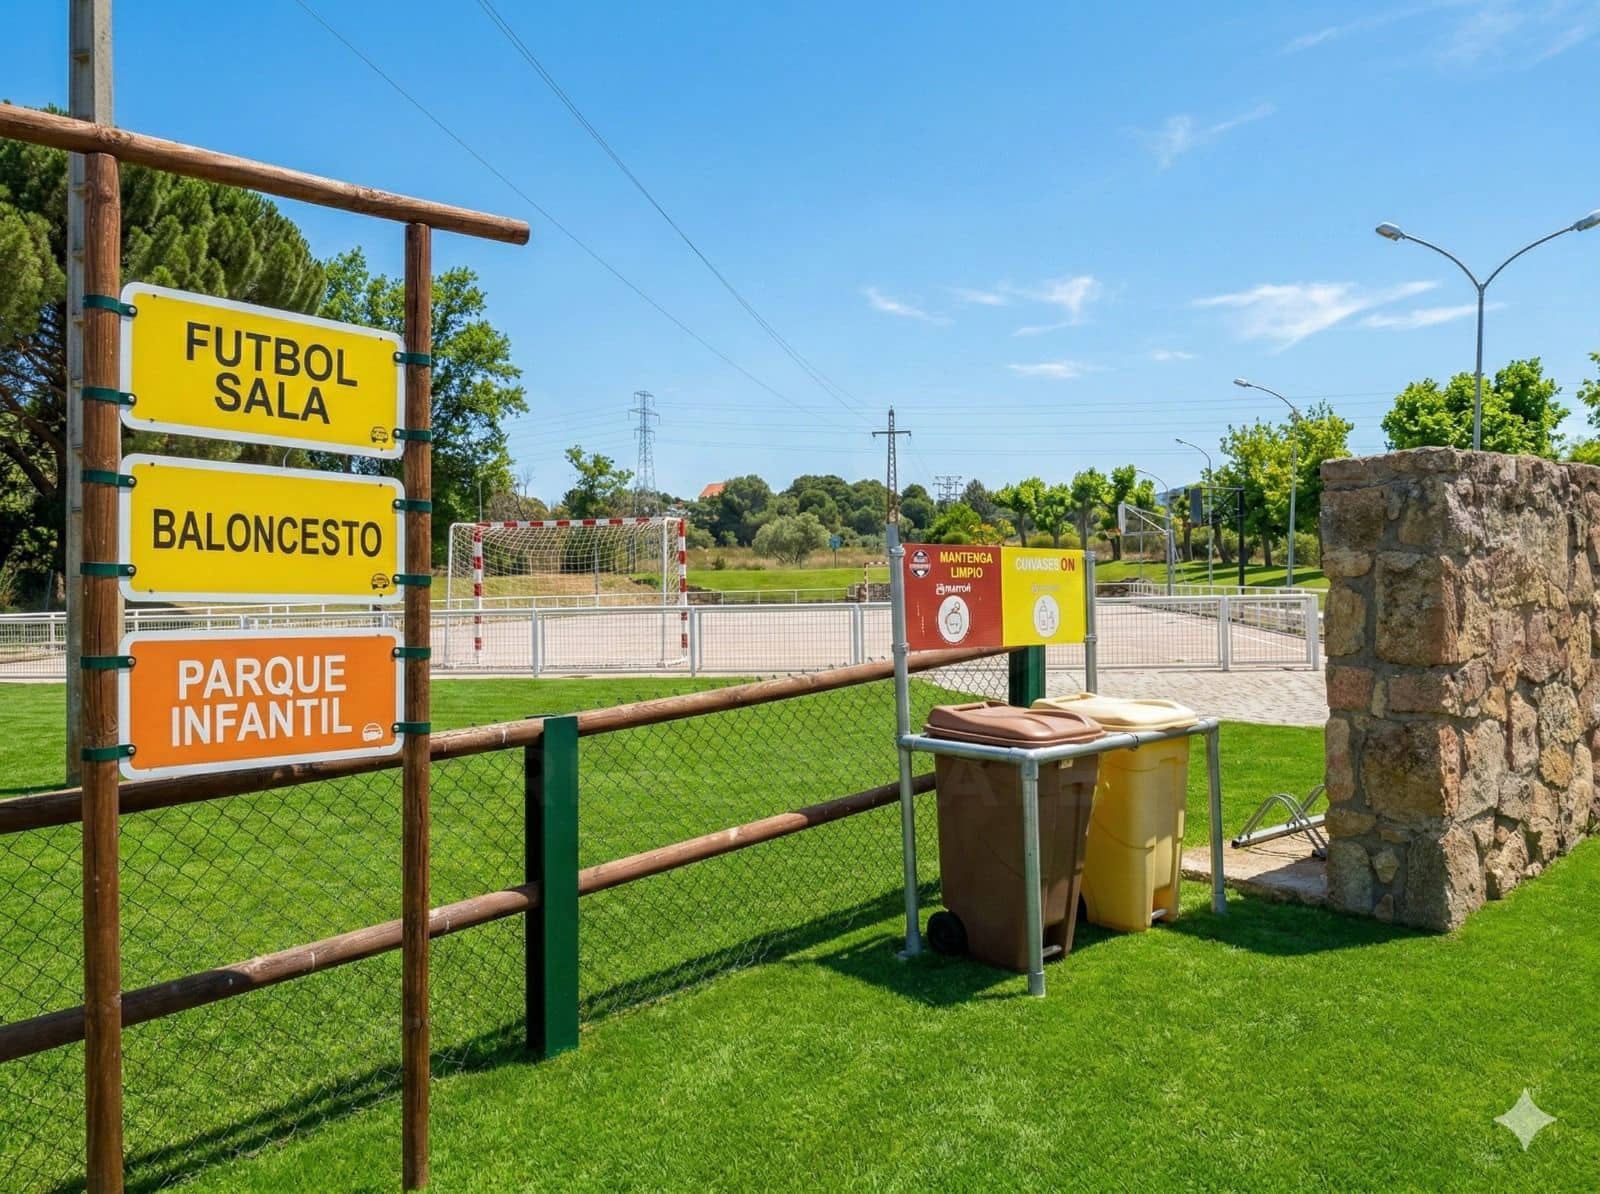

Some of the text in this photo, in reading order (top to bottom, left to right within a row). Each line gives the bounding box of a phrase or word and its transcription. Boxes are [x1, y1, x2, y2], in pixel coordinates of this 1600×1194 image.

[186, 321, 358, 387] FUTBOL
[214, 372, 331, 424] SALA
[152, 508, 383, 557] BALONCESTO
[940, 551, 993, 564] MANTENGA
[951, 566, 983, 578] LIMPIO
[178, 655, 347, 700] PARQUE
[171, 697, 352, 747] INFANTIL
